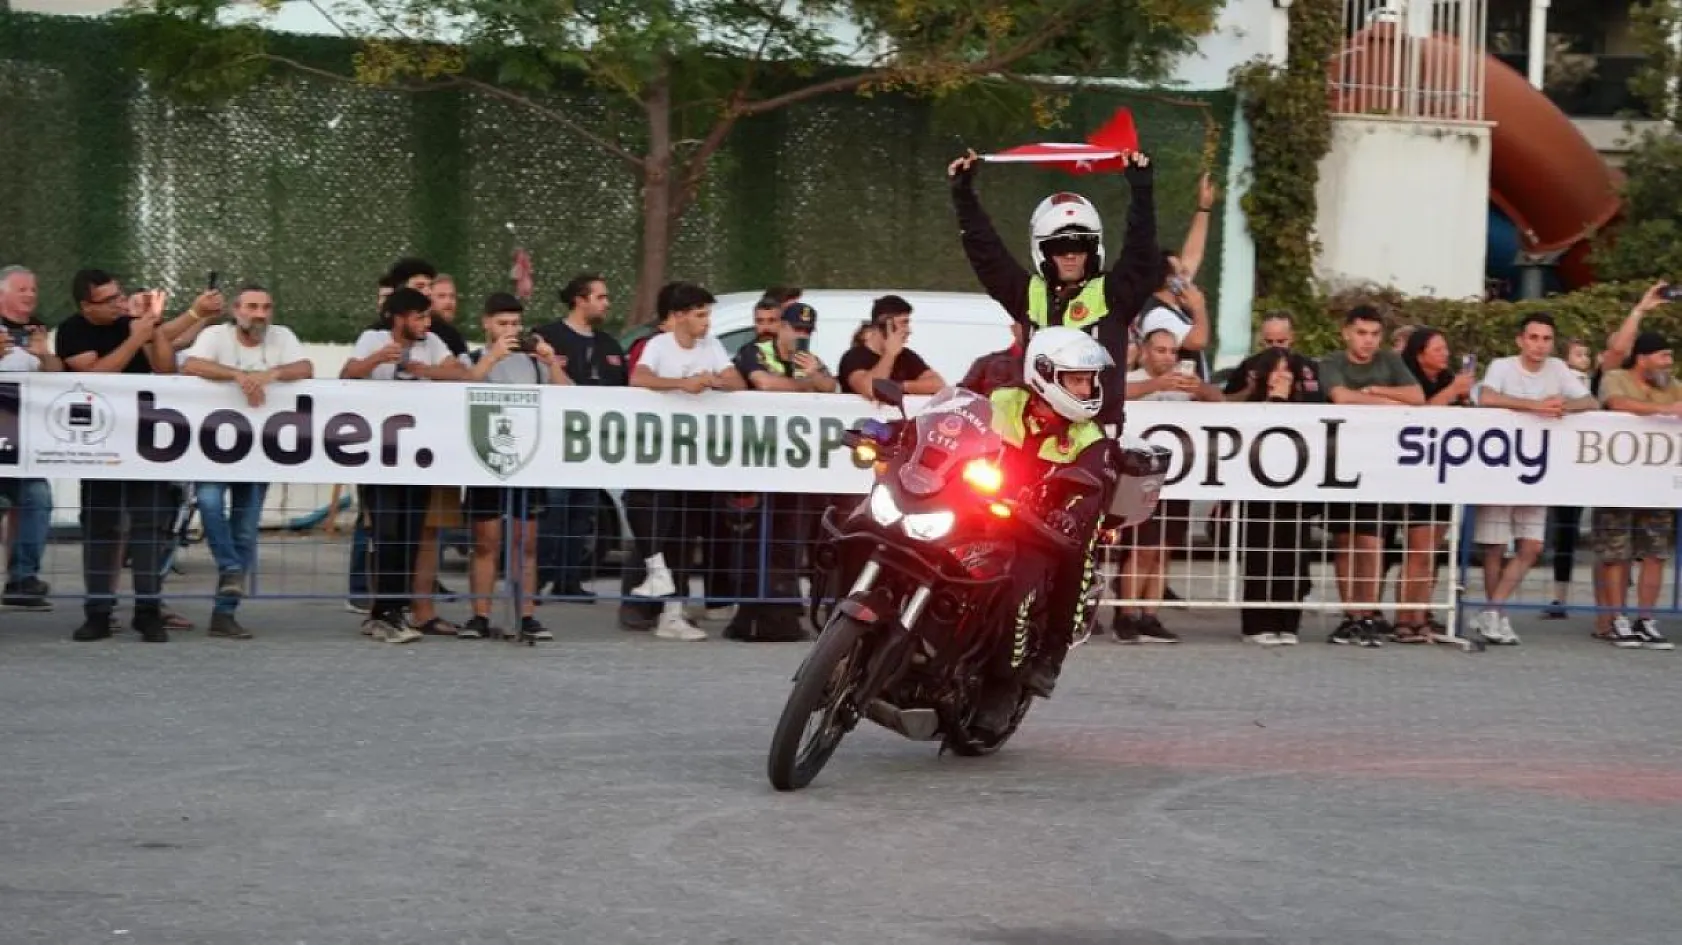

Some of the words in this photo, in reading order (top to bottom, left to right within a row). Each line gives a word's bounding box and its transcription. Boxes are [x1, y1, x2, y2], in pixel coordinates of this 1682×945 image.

[136, 390, 434, 468] boder.
[1397, 426, 1549, 484] sipay
[1575, 430, 1682, 467] BOD
